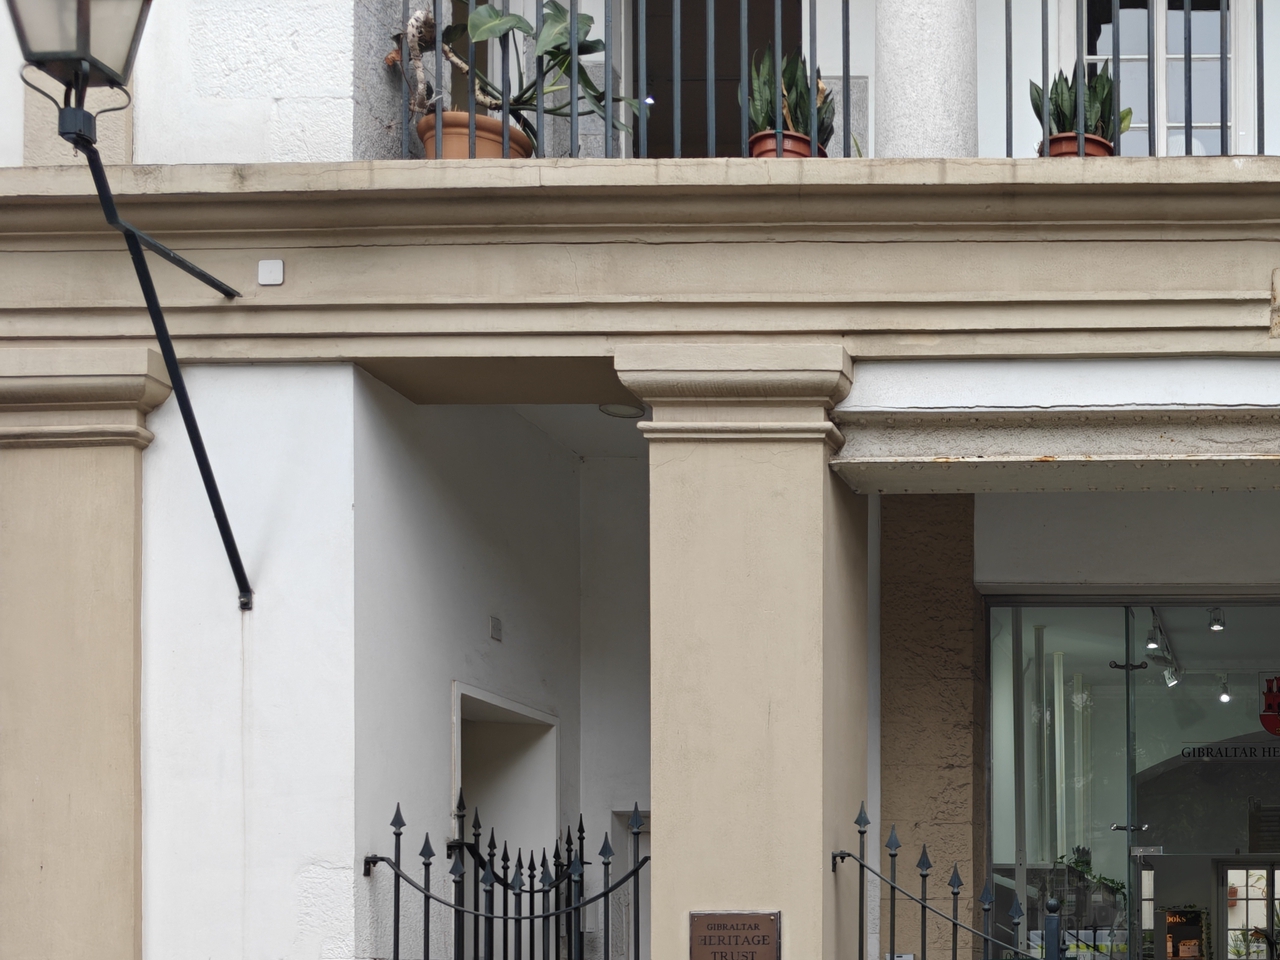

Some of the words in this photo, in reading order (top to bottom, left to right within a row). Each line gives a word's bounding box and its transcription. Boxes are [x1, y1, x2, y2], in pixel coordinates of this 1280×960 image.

[1181, 746, 1259, 758] GIBRALTAR
[1167, 914, 1187, 923] ooks
[706, 923, 761, 931] GIBRALTAR
[698, 935, 771, 946] HERITAGE
